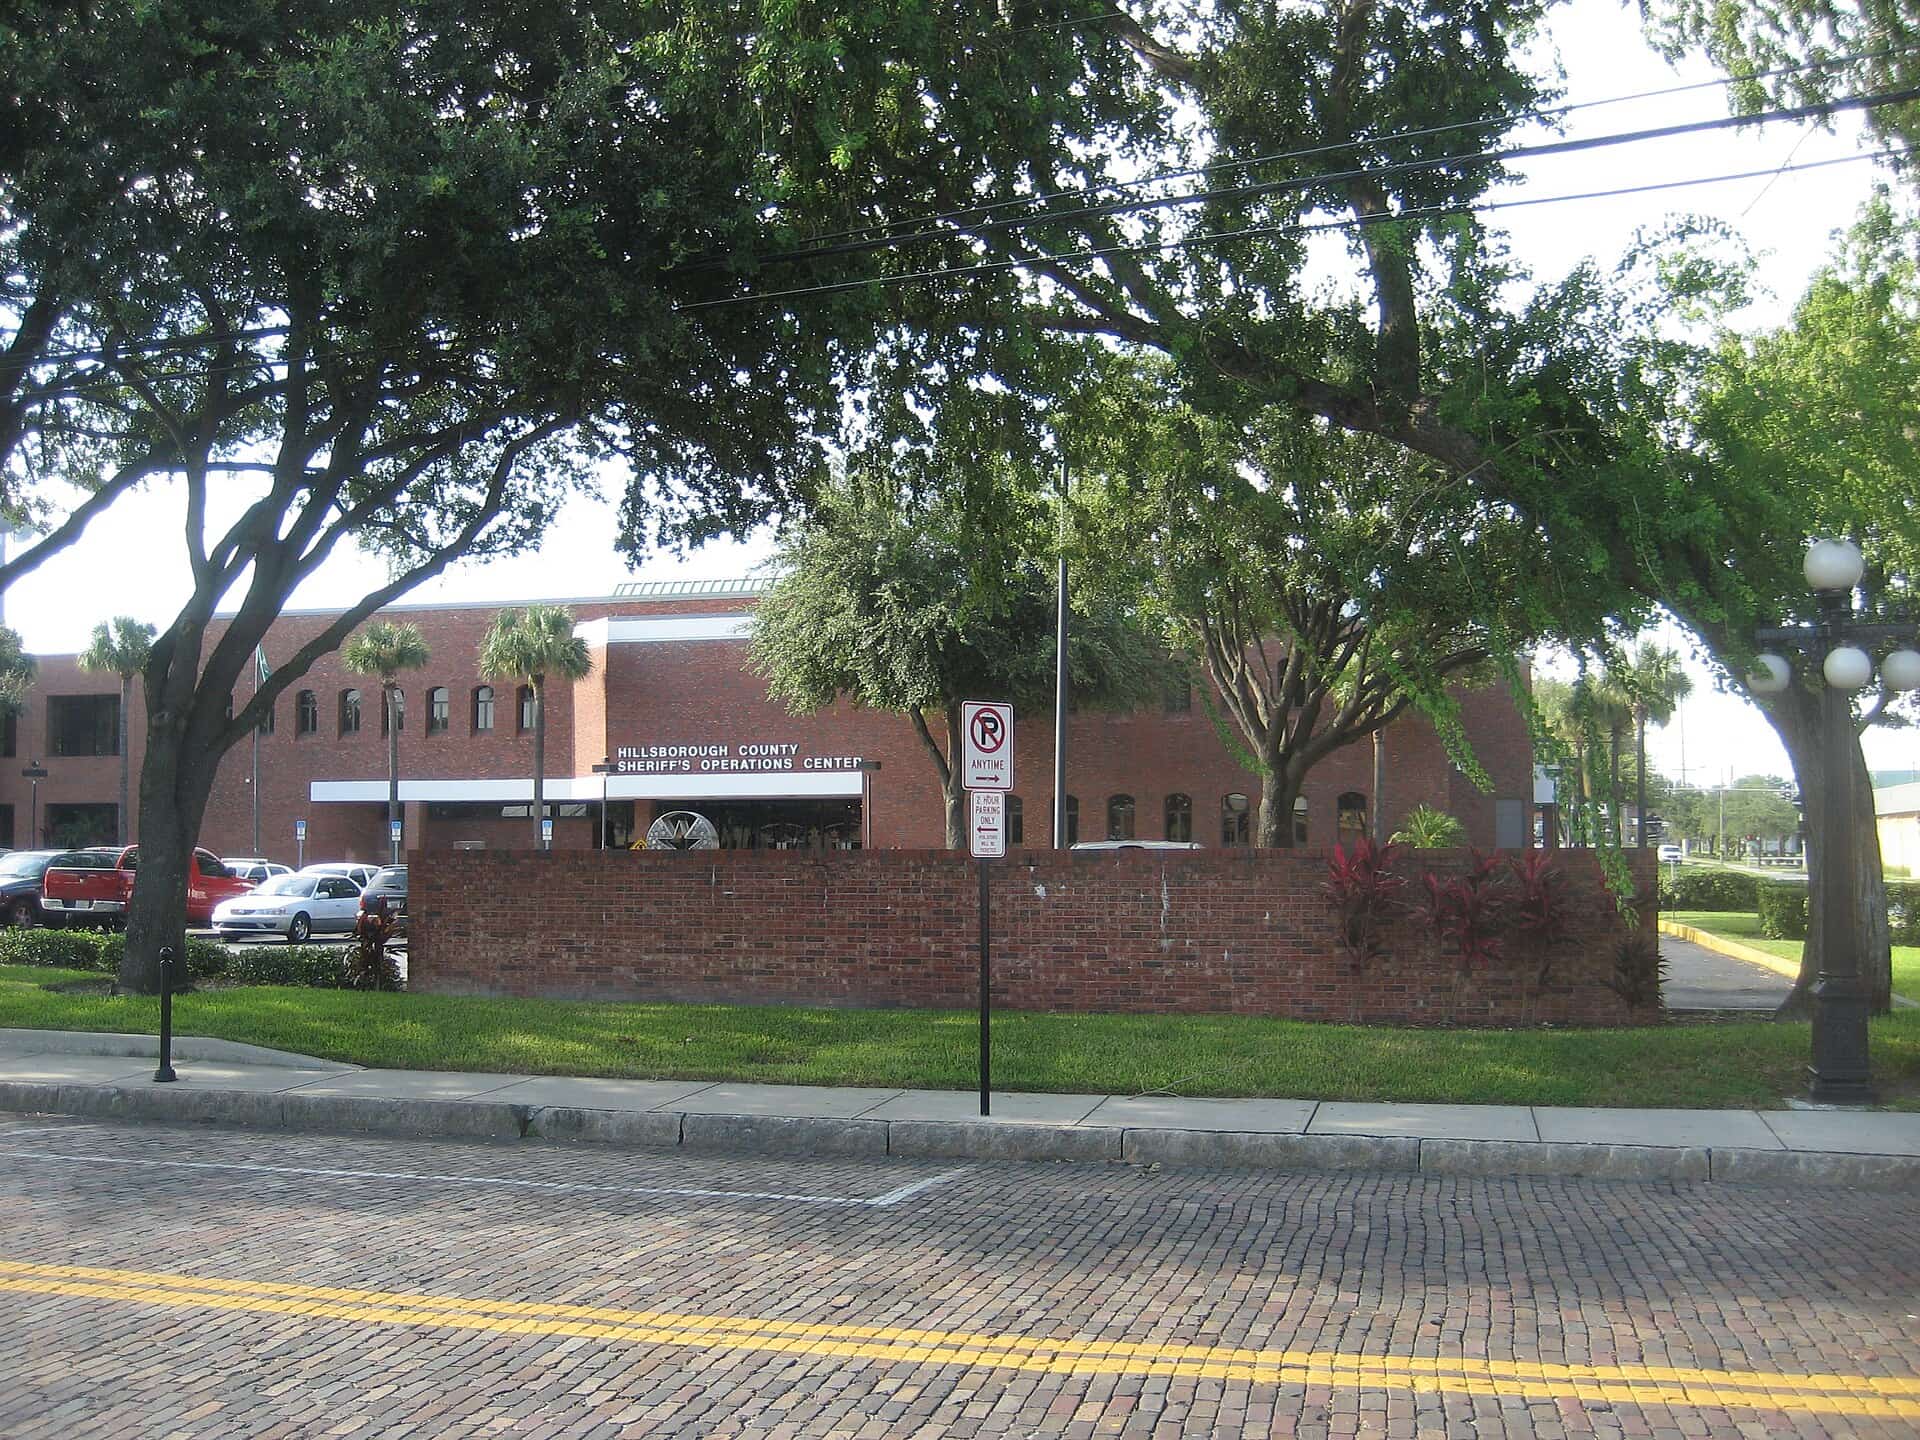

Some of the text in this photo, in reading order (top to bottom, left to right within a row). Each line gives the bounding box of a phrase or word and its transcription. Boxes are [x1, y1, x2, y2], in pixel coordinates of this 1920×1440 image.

[617, 743, 799, 758] HILLSBOROUGH COUNTY
[617, 757, 862, 772] SHERIFF'S OPERATIONS CENTER
[971, 759, 1005, 770] ANYTIME
[983, 795, 1000, 805] HOUR
[976, 805, 1001, 815] PARKING
[980, 815, 995, 825] ONLY
